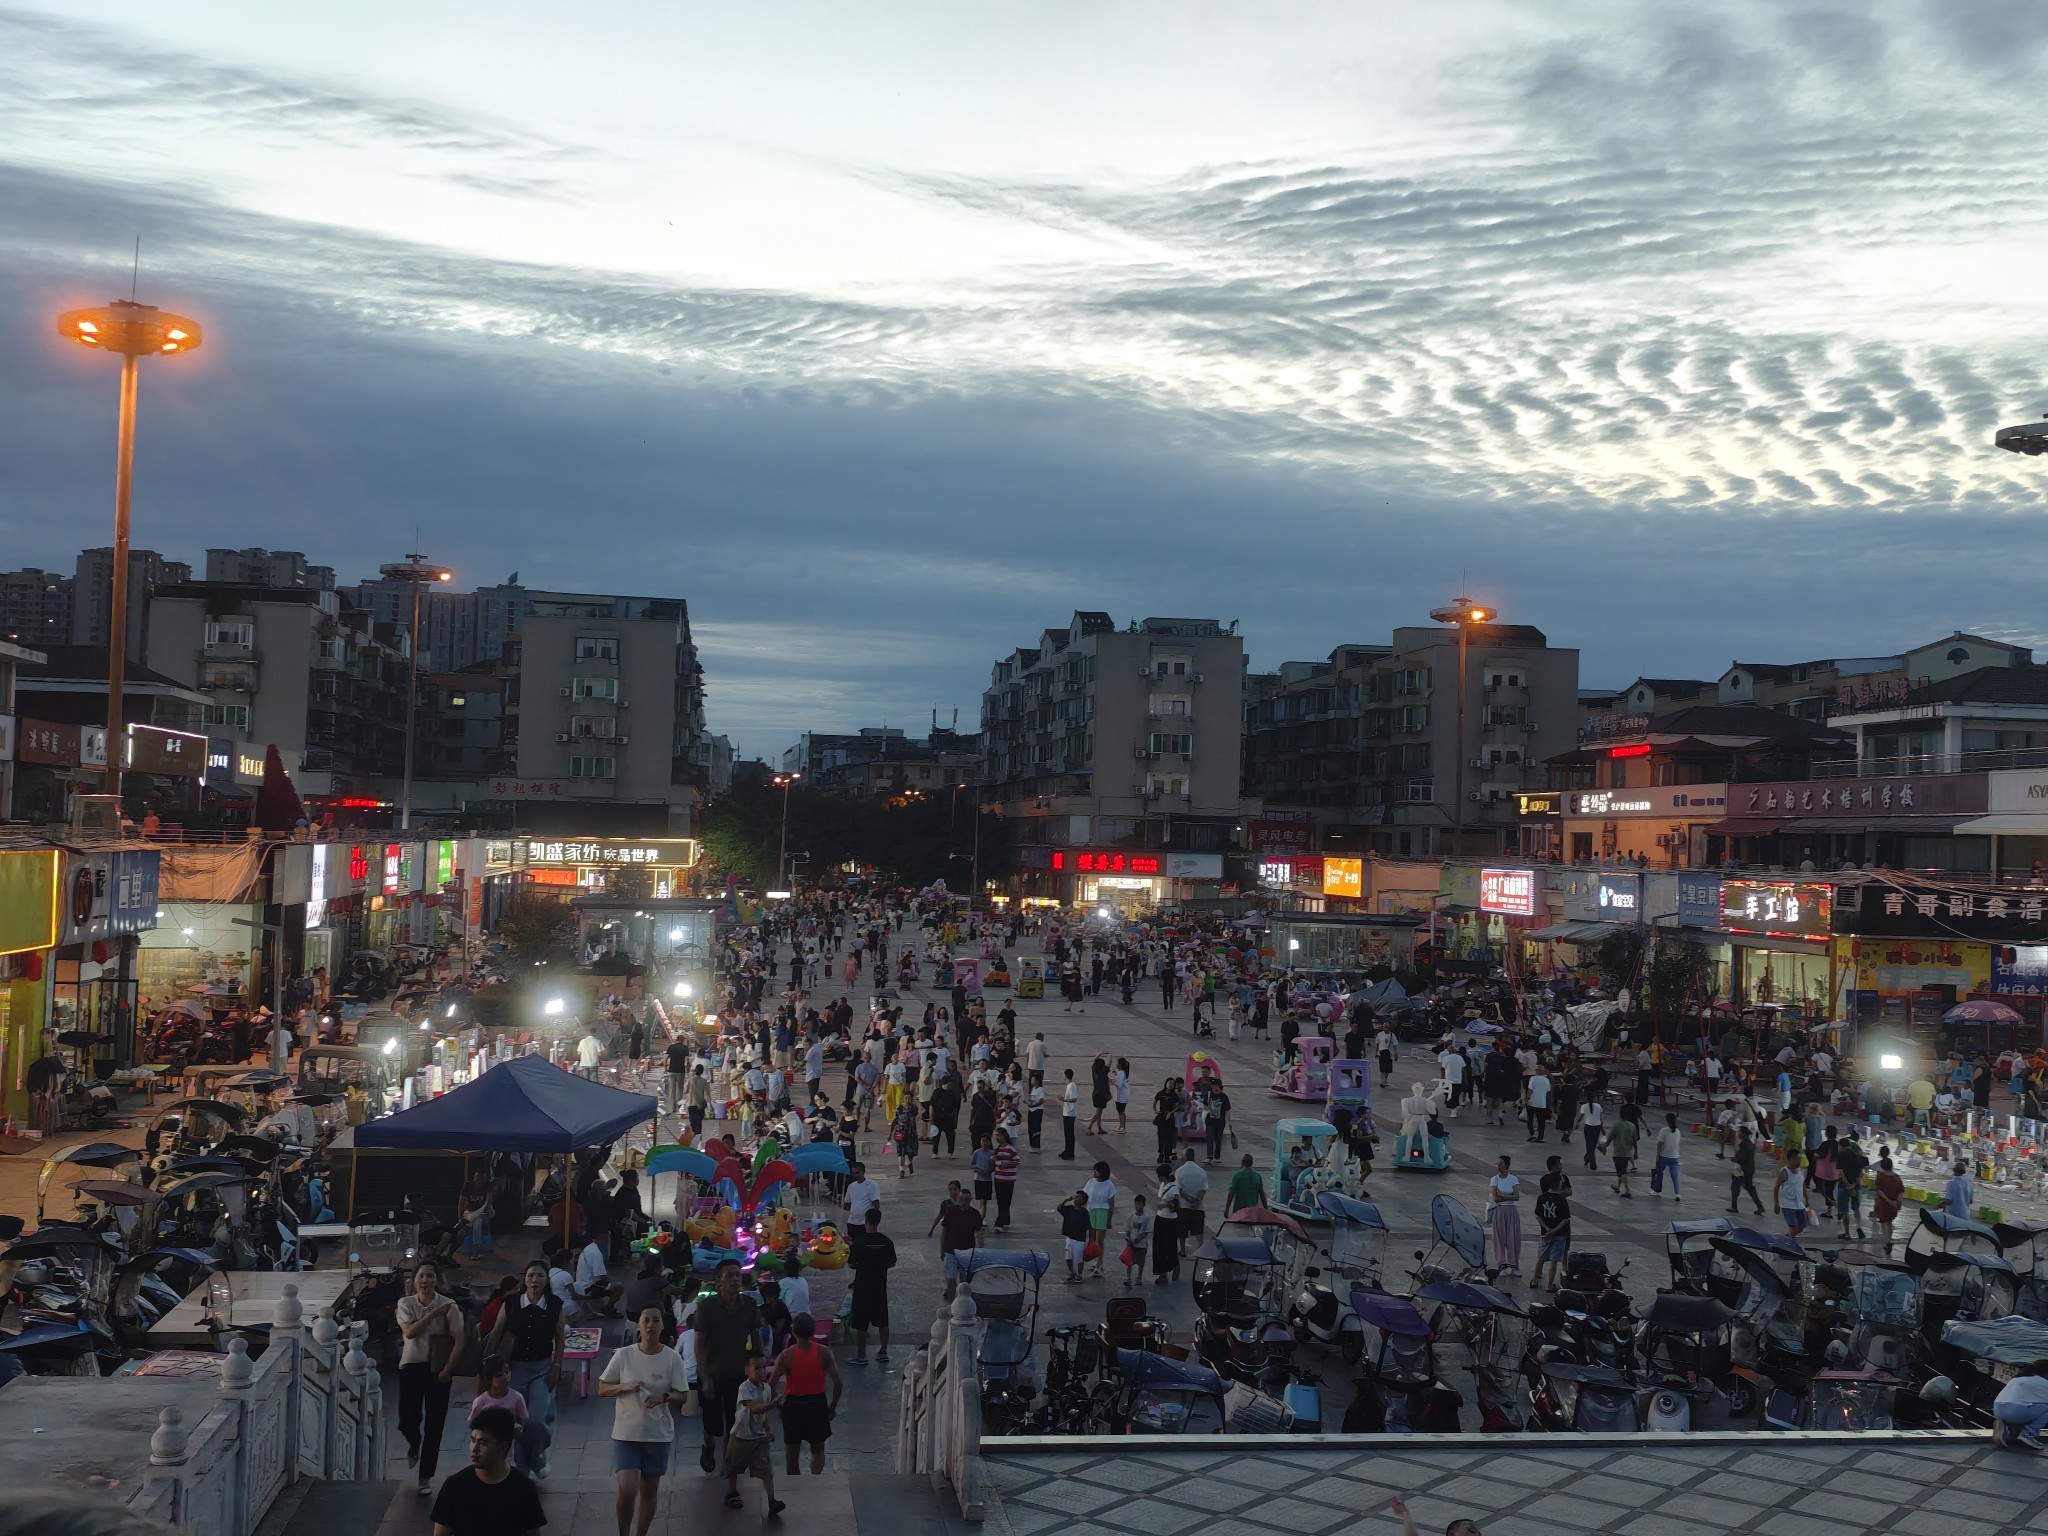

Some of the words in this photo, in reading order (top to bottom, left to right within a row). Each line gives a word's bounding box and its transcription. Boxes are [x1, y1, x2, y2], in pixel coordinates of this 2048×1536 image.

[1257, 829, 1308, 842] 灵风电竞
[529, 843, 600, 861] 凯盛家纺
[604, 848, 659, 862] 床品世界
[1746, 896, 1799, 922] 手工馆
[1883, 892, 2043, 920] 青哥副食酒
[1996, 957, 2048, 976] 名烟名
[1996, 982, 2048, 995] 休闲食
[1542, 1200, 1558, 1219] NY
